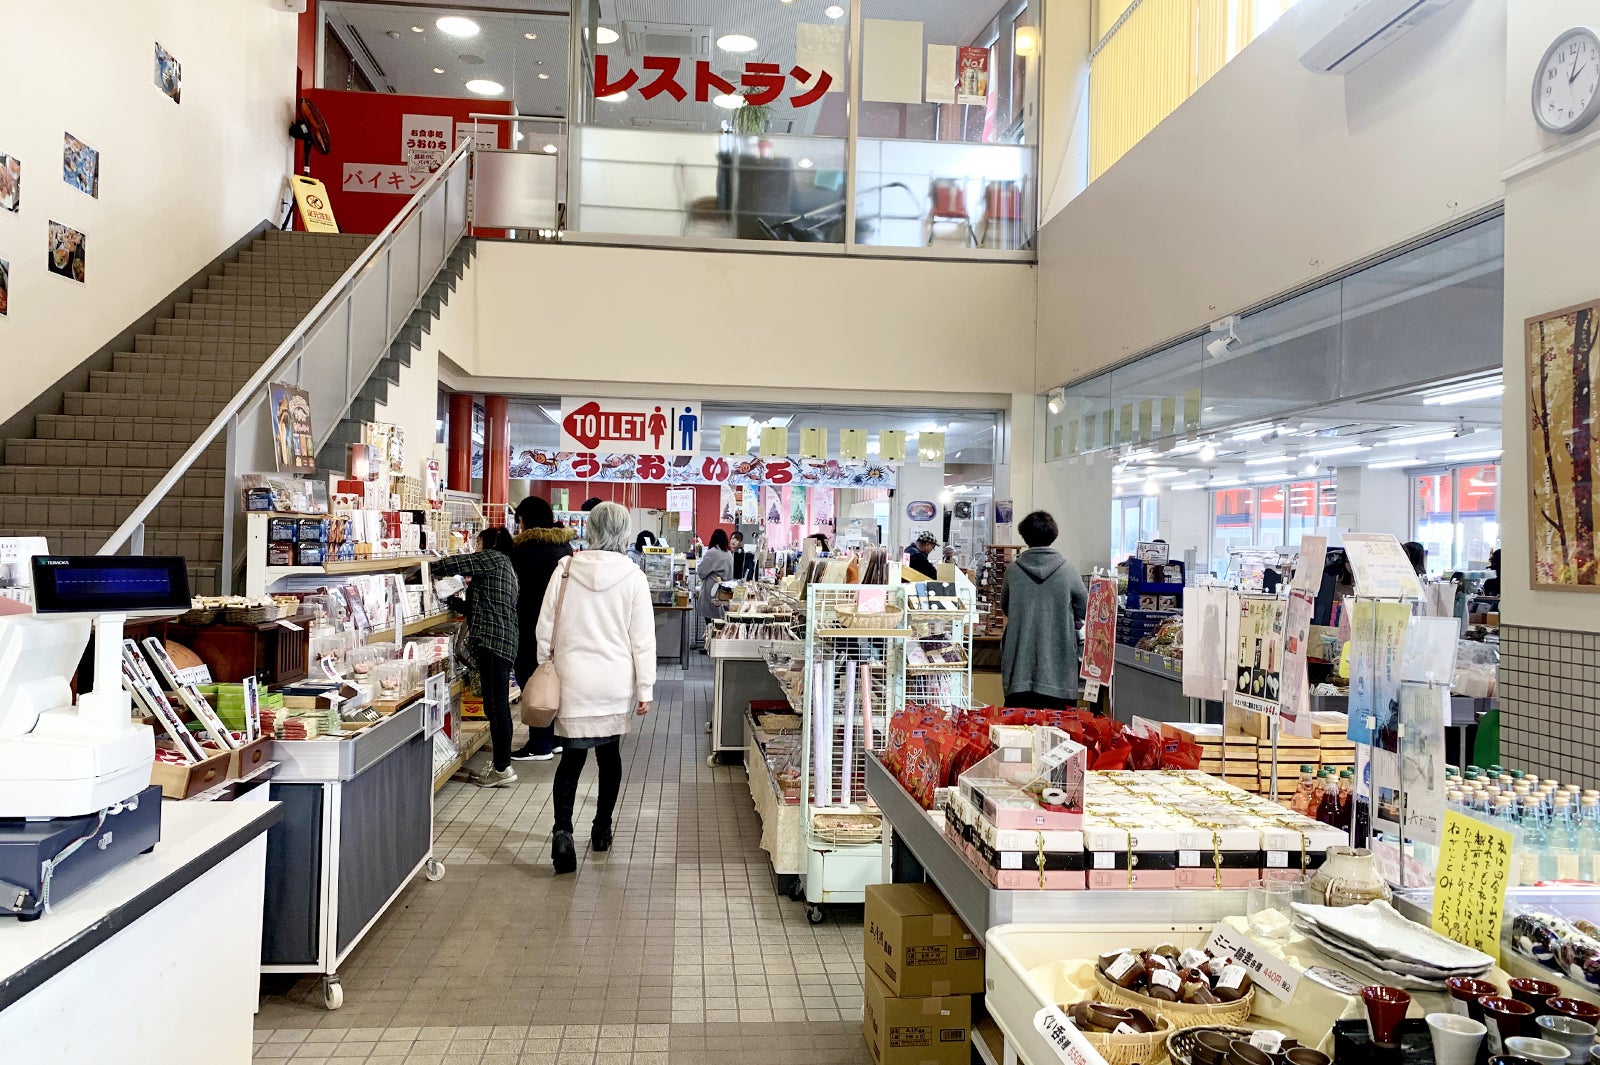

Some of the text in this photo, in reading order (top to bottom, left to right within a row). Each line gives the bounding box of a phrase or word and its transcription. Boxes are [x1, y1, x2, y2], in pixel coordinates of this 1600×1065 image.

[961, 57, 985, 68] No.1
[594, 54, 833, 108] レストラン
[407, 139, 447, 149] うおいち
[411, 129, 443, 138] お食事処
[573, 414, 645, 439] TOILET
[571, 452, 793, 484] うおいち
[1263, 967, 1282, 986] 440円
[1043, 1014, 1072, 1051] ぐい呑各種
